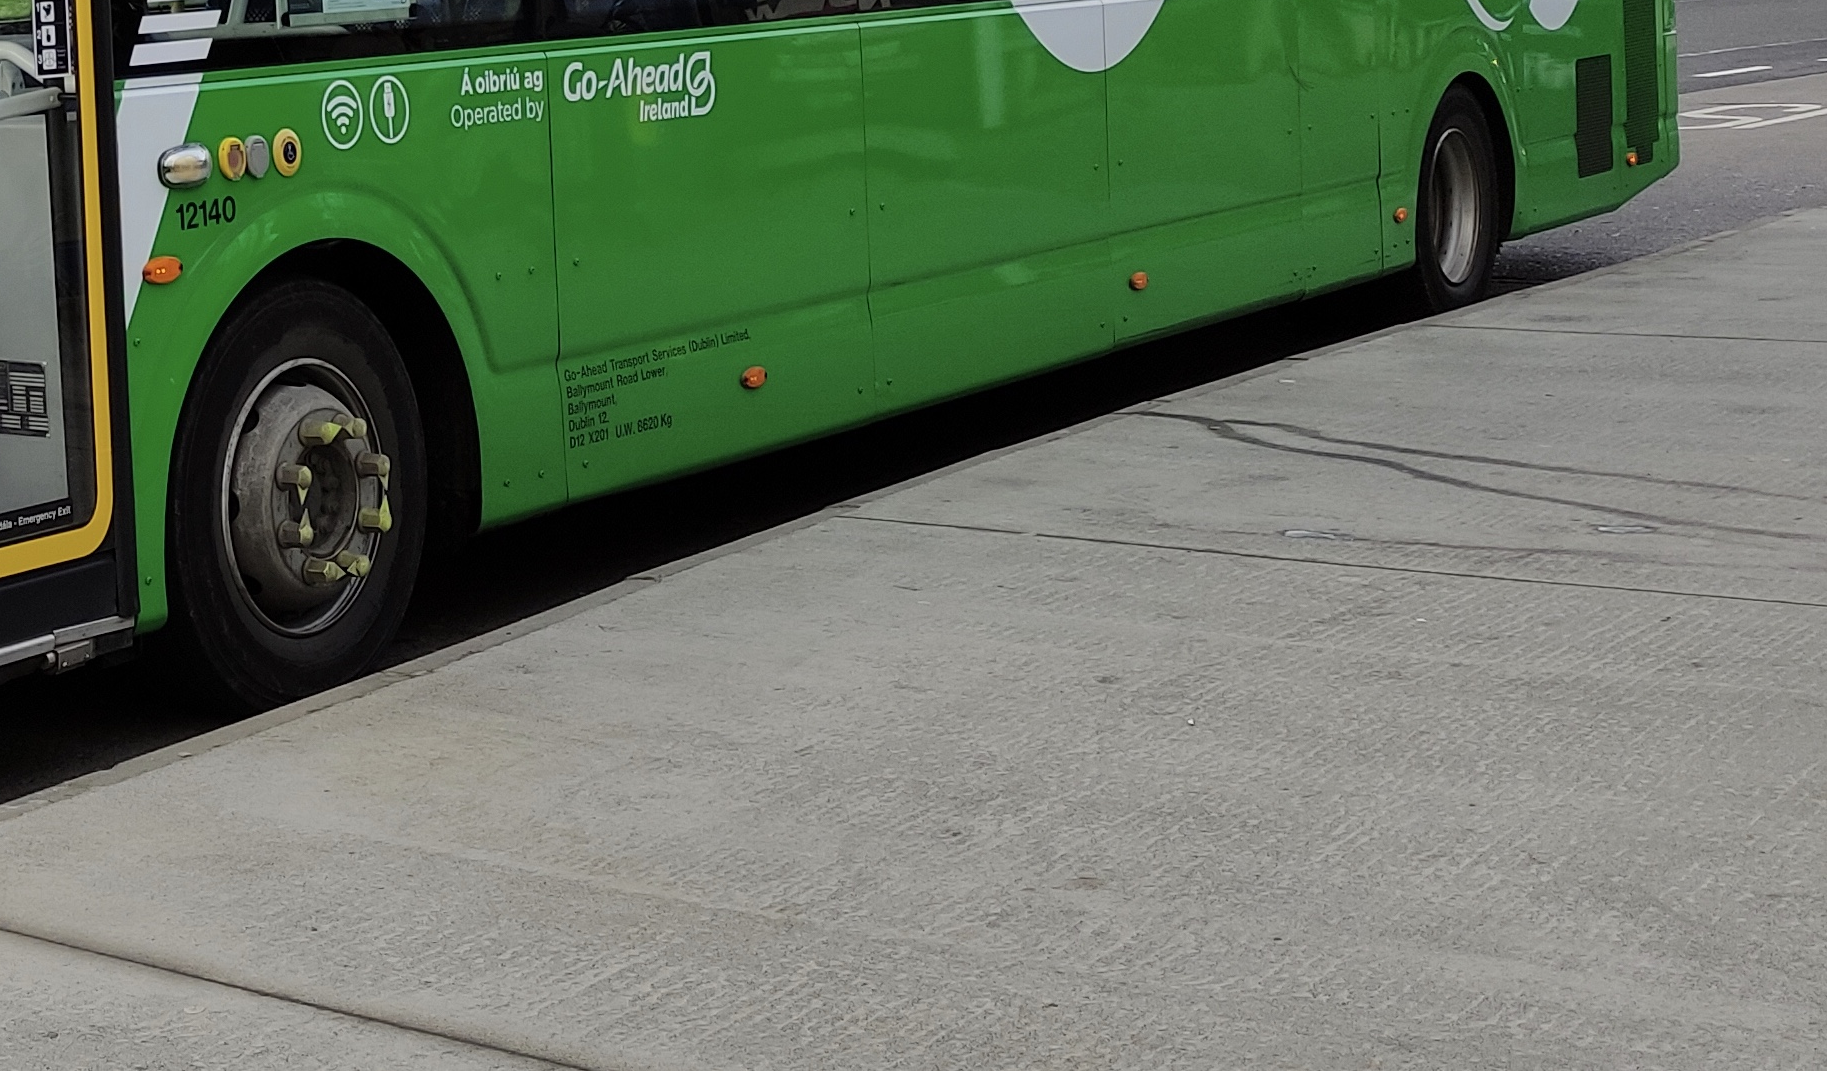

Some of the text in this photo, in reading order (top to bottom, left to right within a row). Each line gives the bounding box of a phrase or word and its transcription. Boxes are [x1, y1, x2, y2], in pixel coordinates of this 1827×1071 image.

[475, 66, 521, 95] oibriú
[524, 69, 544, 92] ag
[563, 52, 685, 103] Go-Ahead
[450, 96, 545, 131] Operated by
[639, 94, 689, 123] Ireland
[176, 195, 237, 231] 12140
[564, 358, 608, 382] Go-Ahead
[609, 352, 651, 375] Transport
[652, 344, 687, 362] Services
[688, 334, 720, 353] (Dublin)
[566, 376, 615, 399] Ballymount
[617, 371, 639, 387] Road
[568, 416, 595, 432] Dublin
[569, 433, 586, 449] D12
[588, 428, 610, 444] X201
[637, 415, 659, 433] 8620
[660, 412, 673, 429] Kg
[18, 510, 57, 527] Emergency
[57, 505, 72, 517] Exit
